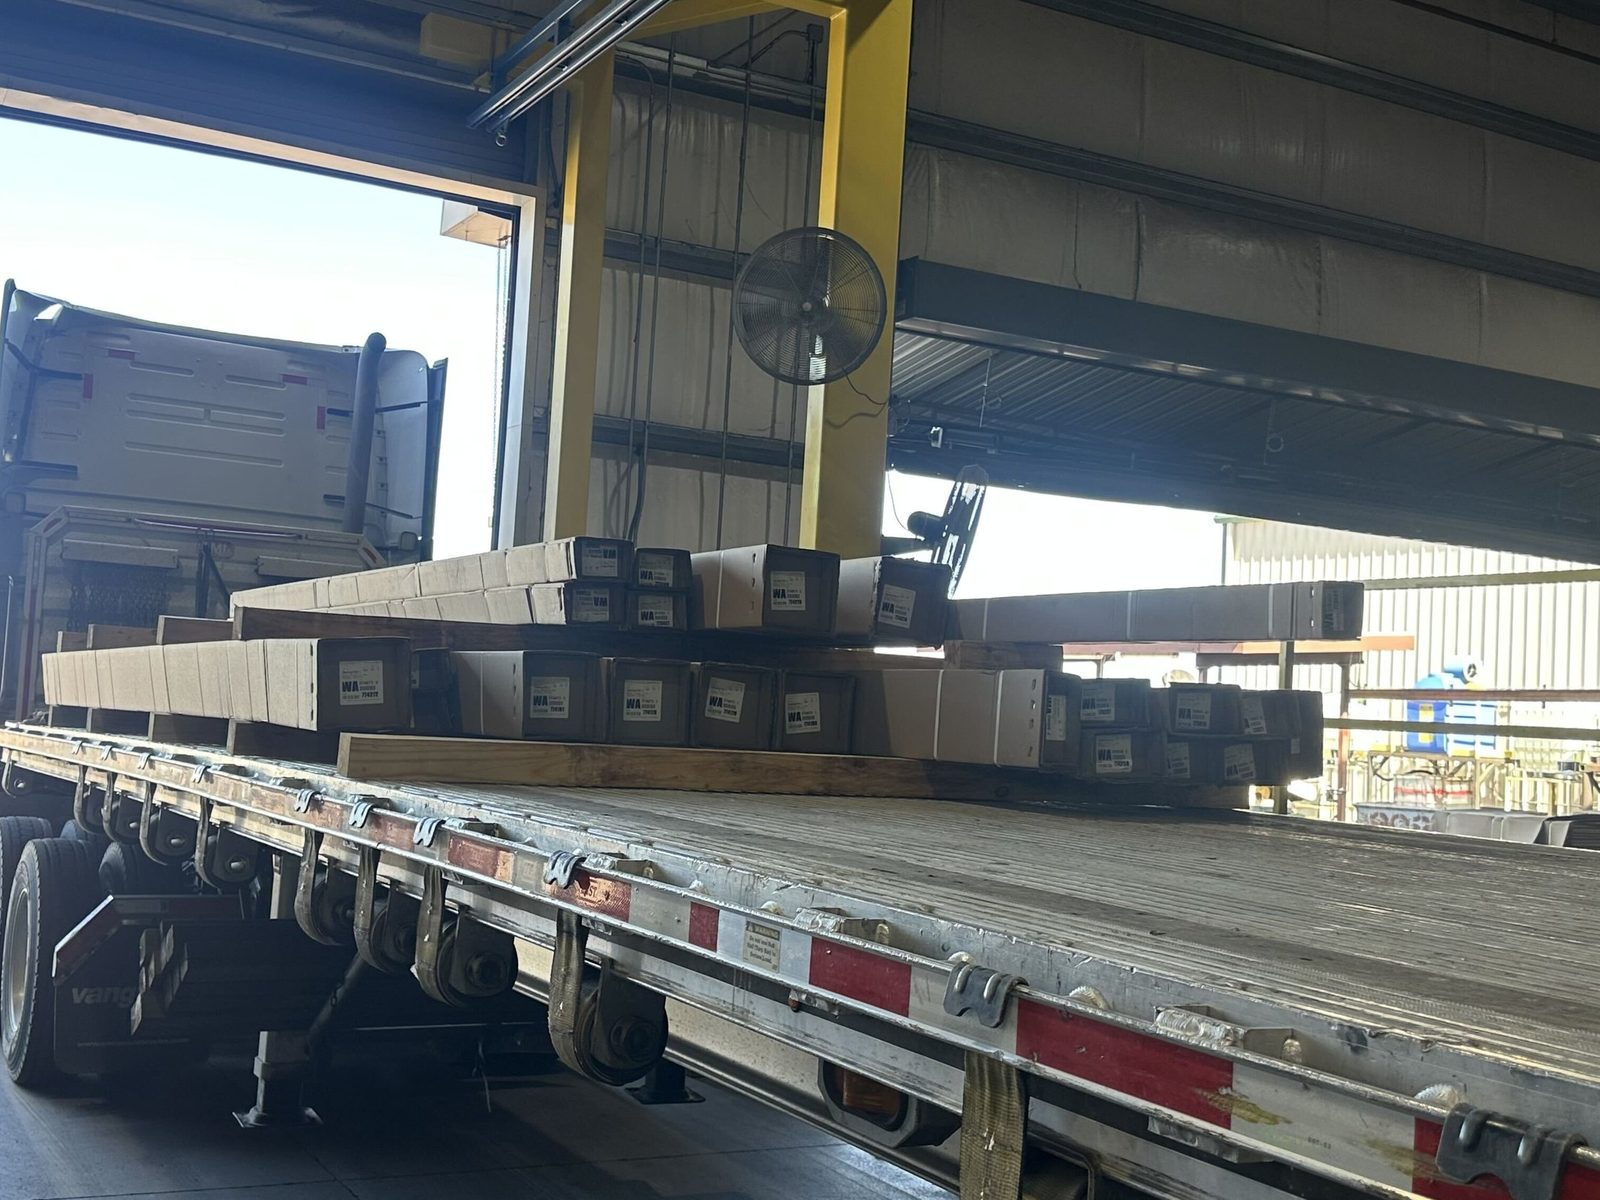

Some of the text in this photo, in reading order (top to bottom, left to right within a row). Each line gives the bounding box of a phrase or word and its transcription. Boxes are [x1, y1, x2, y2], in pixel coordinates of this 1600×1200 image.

[640, 570, 654, 581] WA
[773, 588, 787, 599] WA
[882, 602, 895, 614] WA
[640, 608, 654, 621] WA
[342, 680, 359, 692] WA
[533, 695, 549, 706] WA
[626, 698, 641, 709] WA
[709, 695, 723, 708] WA
[1082, 698, 1096, 710] WA
[788, 711, 802, 722] WA
[1179, 708, 1192, 720] WA
[1098, 749, 1112, 761] WA
